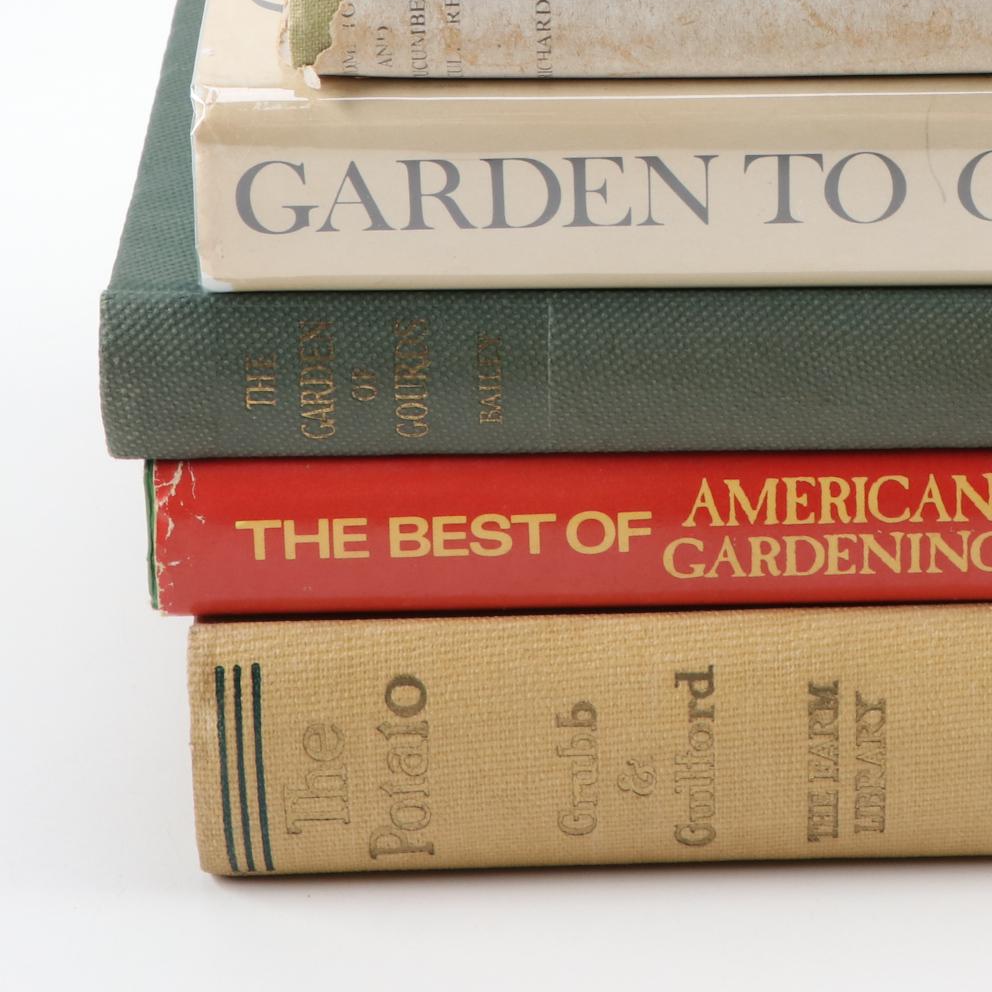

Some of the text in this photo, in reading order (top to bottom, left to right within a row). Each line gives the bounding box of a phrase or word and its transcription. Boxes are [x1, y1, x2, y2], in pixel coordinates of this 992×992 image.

[235, 154, 719, 235] GARDEN
[744, 151, 908, 224] TO
[246, 352, 277, 410] THE
[301, 320, 336, 440] GARDEN
[352, 368, 377, 401] OF
[395, 319, 429, 438] GOURDS
[479, 331, 502, 424] BAILEY
[235, 511, 653, 560] THE BEST OF
[283, 722, 350, 835] The
[368, 673, 434, 859] Potato
[555, 700, 598, 836] Grubb
[617, 759, 657, 797] &
[674, 664, 716, 846] Guilford
[807, 680, 840, 842] THE FARM
[854, 690, 887, 833] LIBRARY
